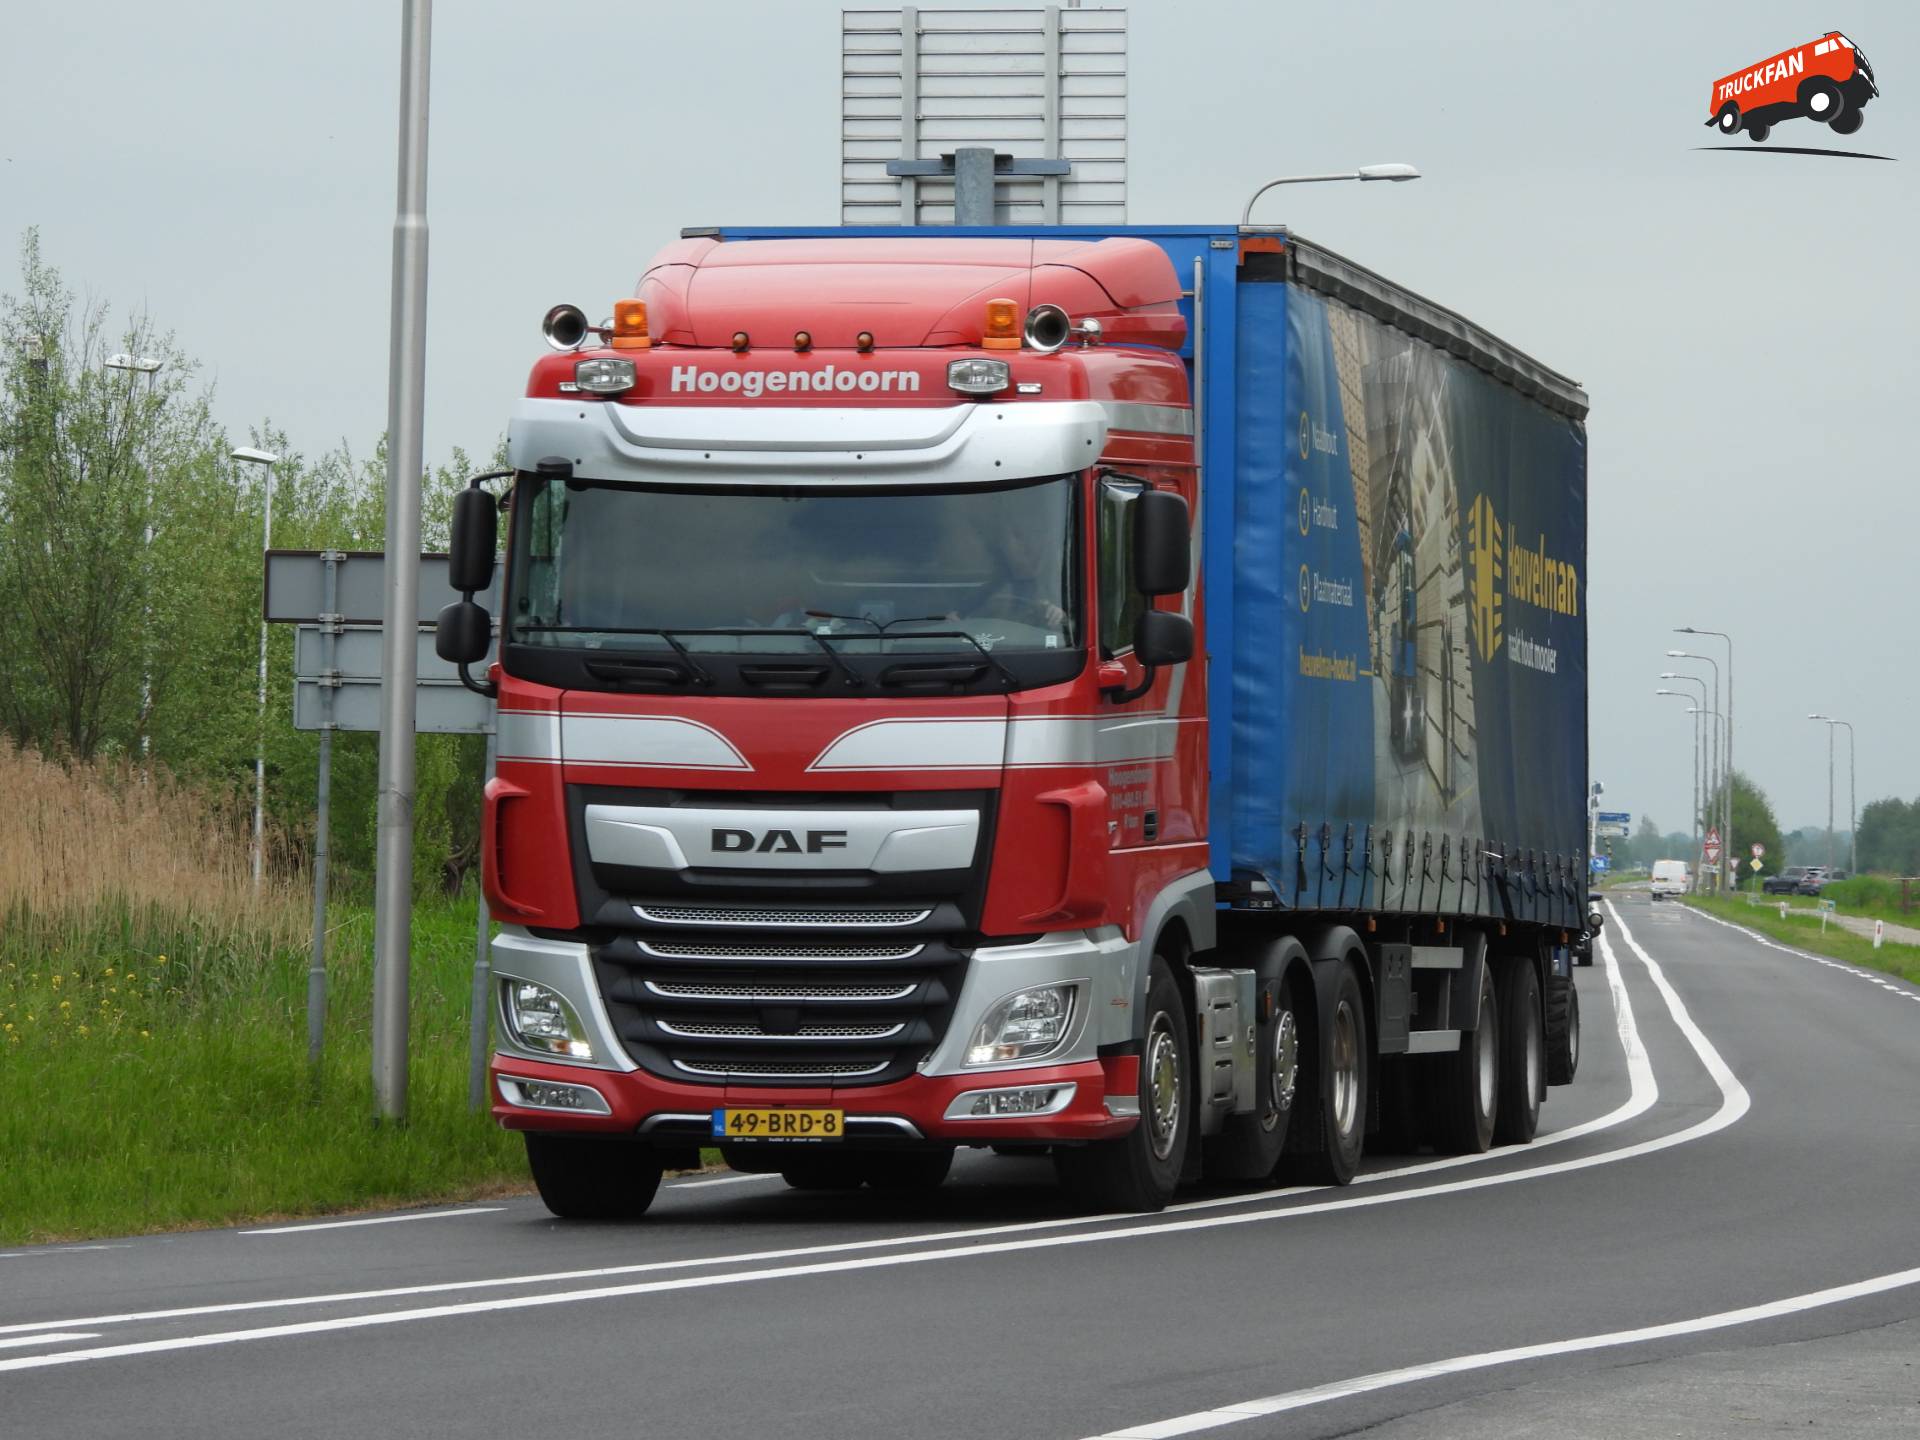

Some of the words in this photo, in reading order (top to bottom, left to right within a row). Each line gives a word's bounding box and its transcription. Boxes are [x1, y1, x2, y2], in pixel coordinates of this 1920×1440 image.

[671, 365, 920, 397] Hoogendoorn
[1508, 521, 1577, 617] Heuvelman
[711, 828, 848, 853] DAF
[730, 1112, 836, 1133] 49-BRD-8
